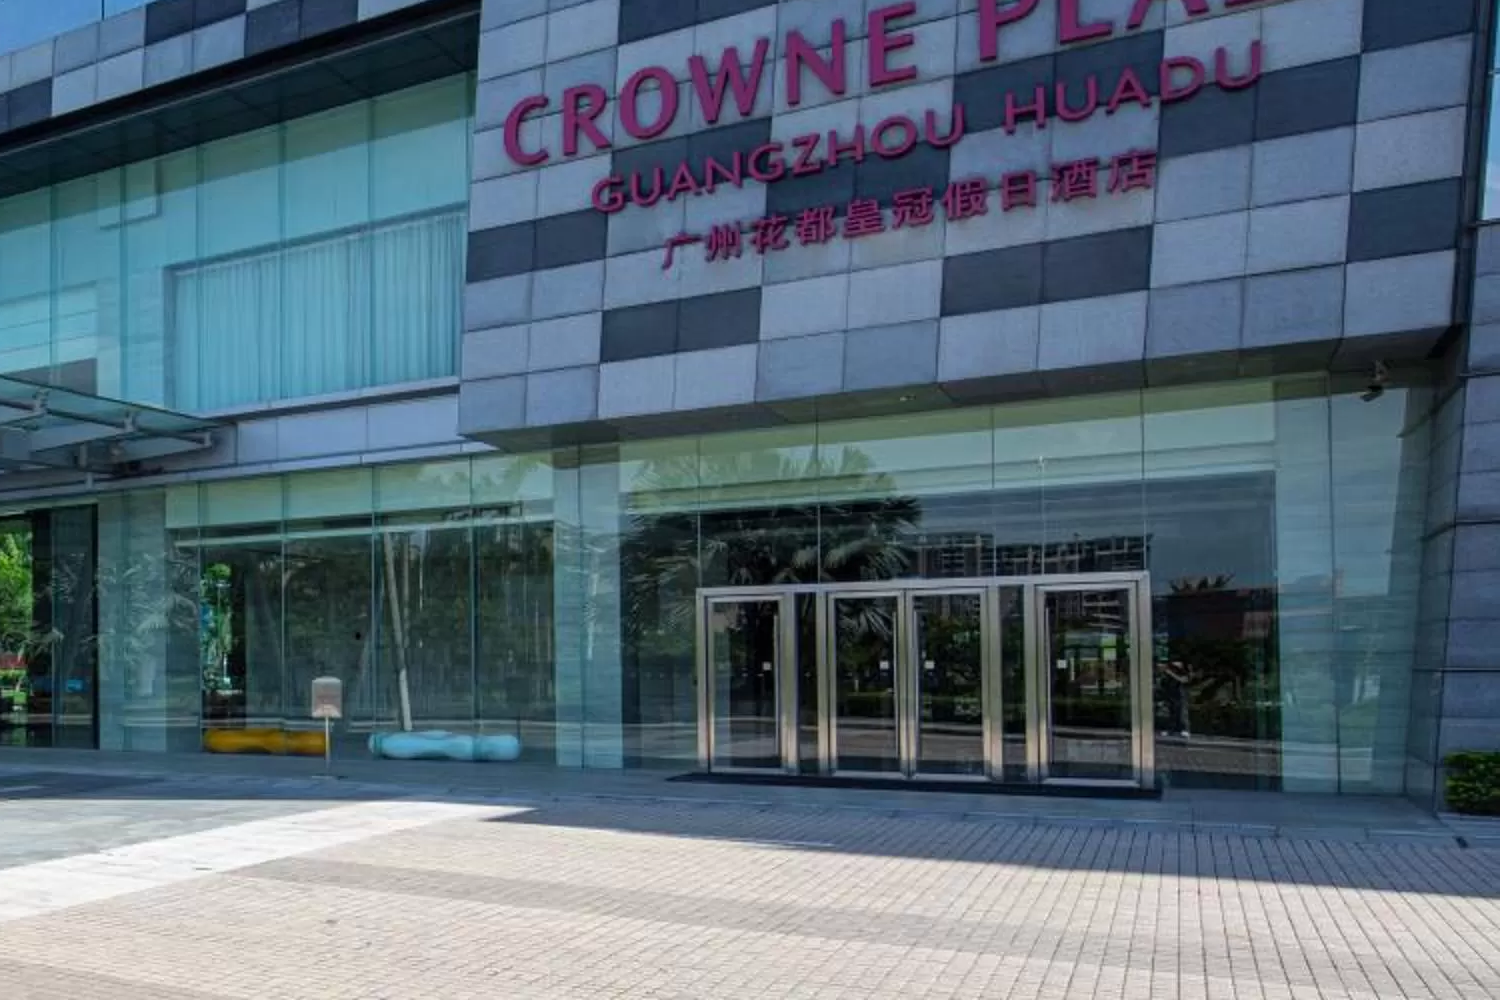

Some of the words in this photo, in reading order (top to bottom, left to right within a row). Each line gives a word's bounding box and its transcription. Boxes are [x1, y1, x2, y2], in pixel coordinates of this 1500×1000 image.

[502, 1, 918, 167] CROWNE
[590, 104, 966, 214] GUANGZHOU
[1003, 39, 1264, 132] HUADU
[661, 148, 1158, 271] 广州花都皇冠假日酒店
